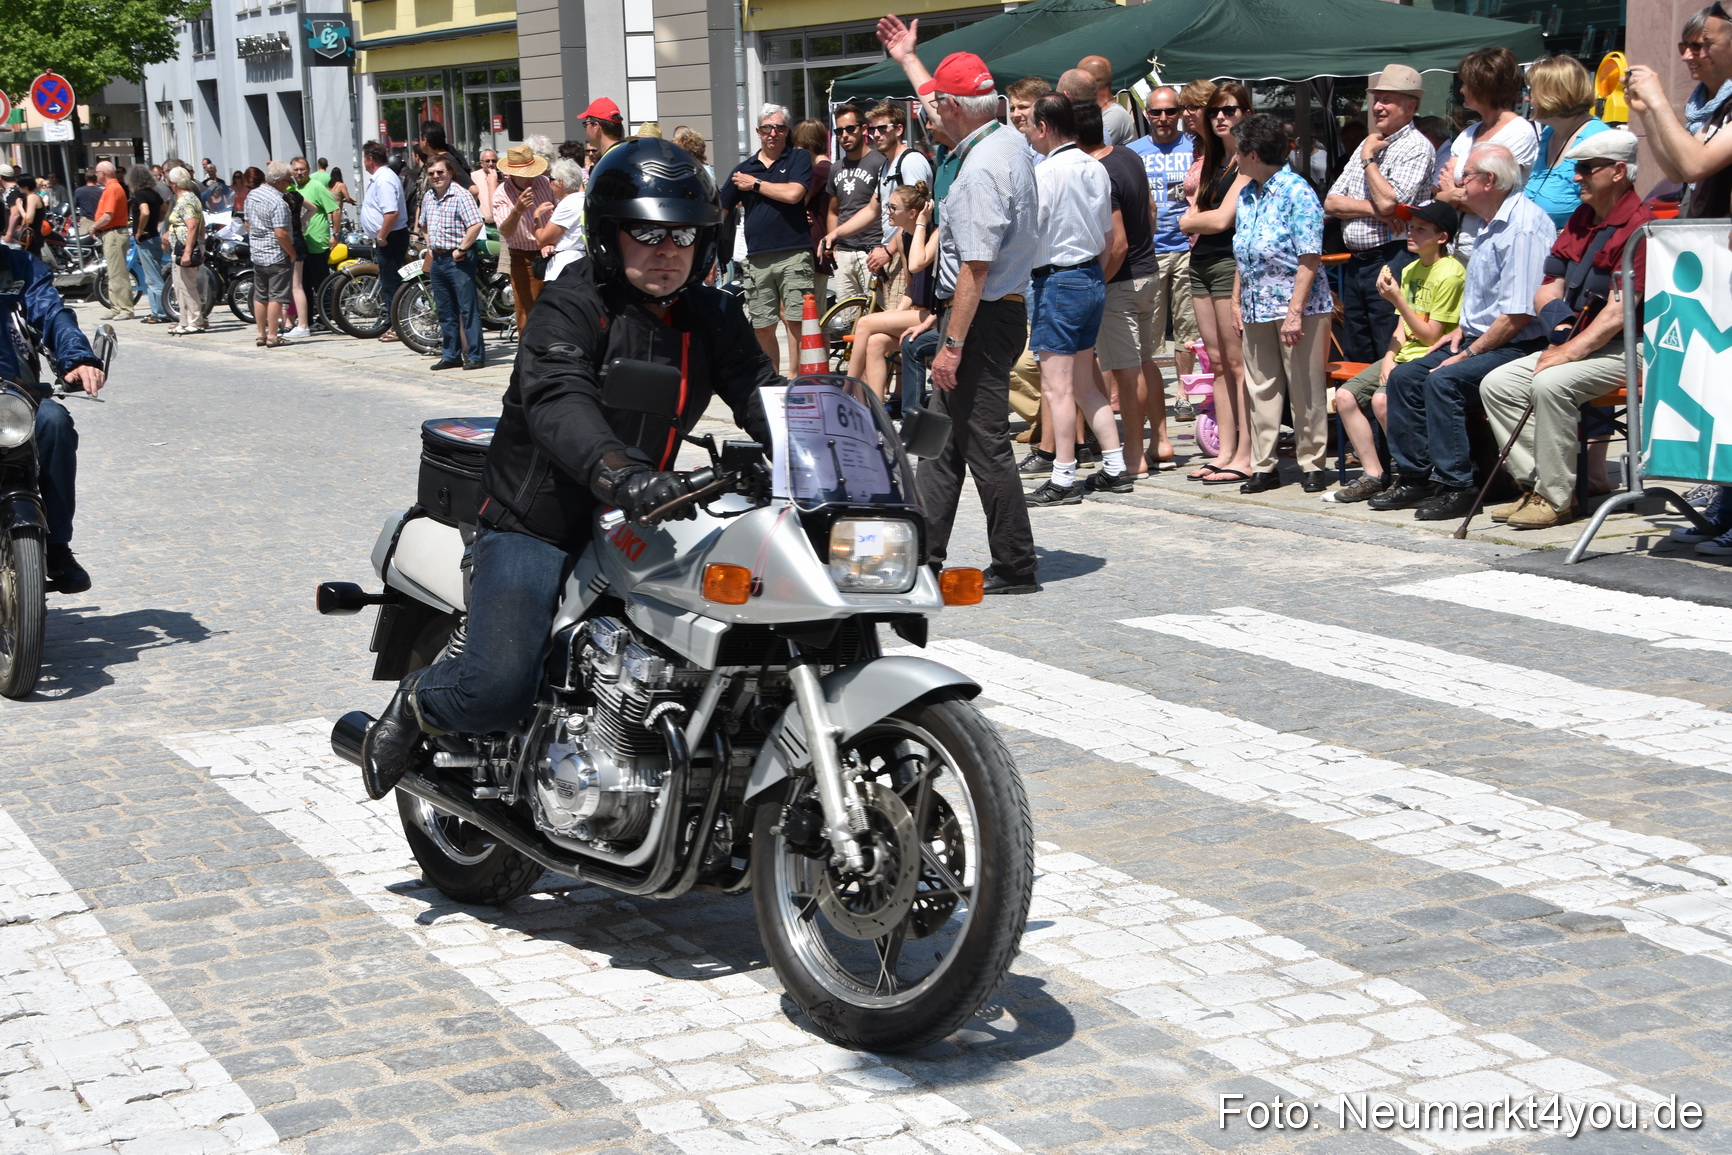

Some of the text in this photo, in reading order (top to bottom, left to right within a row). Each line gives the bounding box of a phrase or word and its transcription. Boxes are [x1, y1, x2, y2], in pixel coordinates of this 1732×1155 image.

[320, 27, 338, 50] G2
[833, 168, 874, 187] ZOO YORK
[1166, 171, 1188, 182] THIRS
[837, 403, 865, 434] 617
